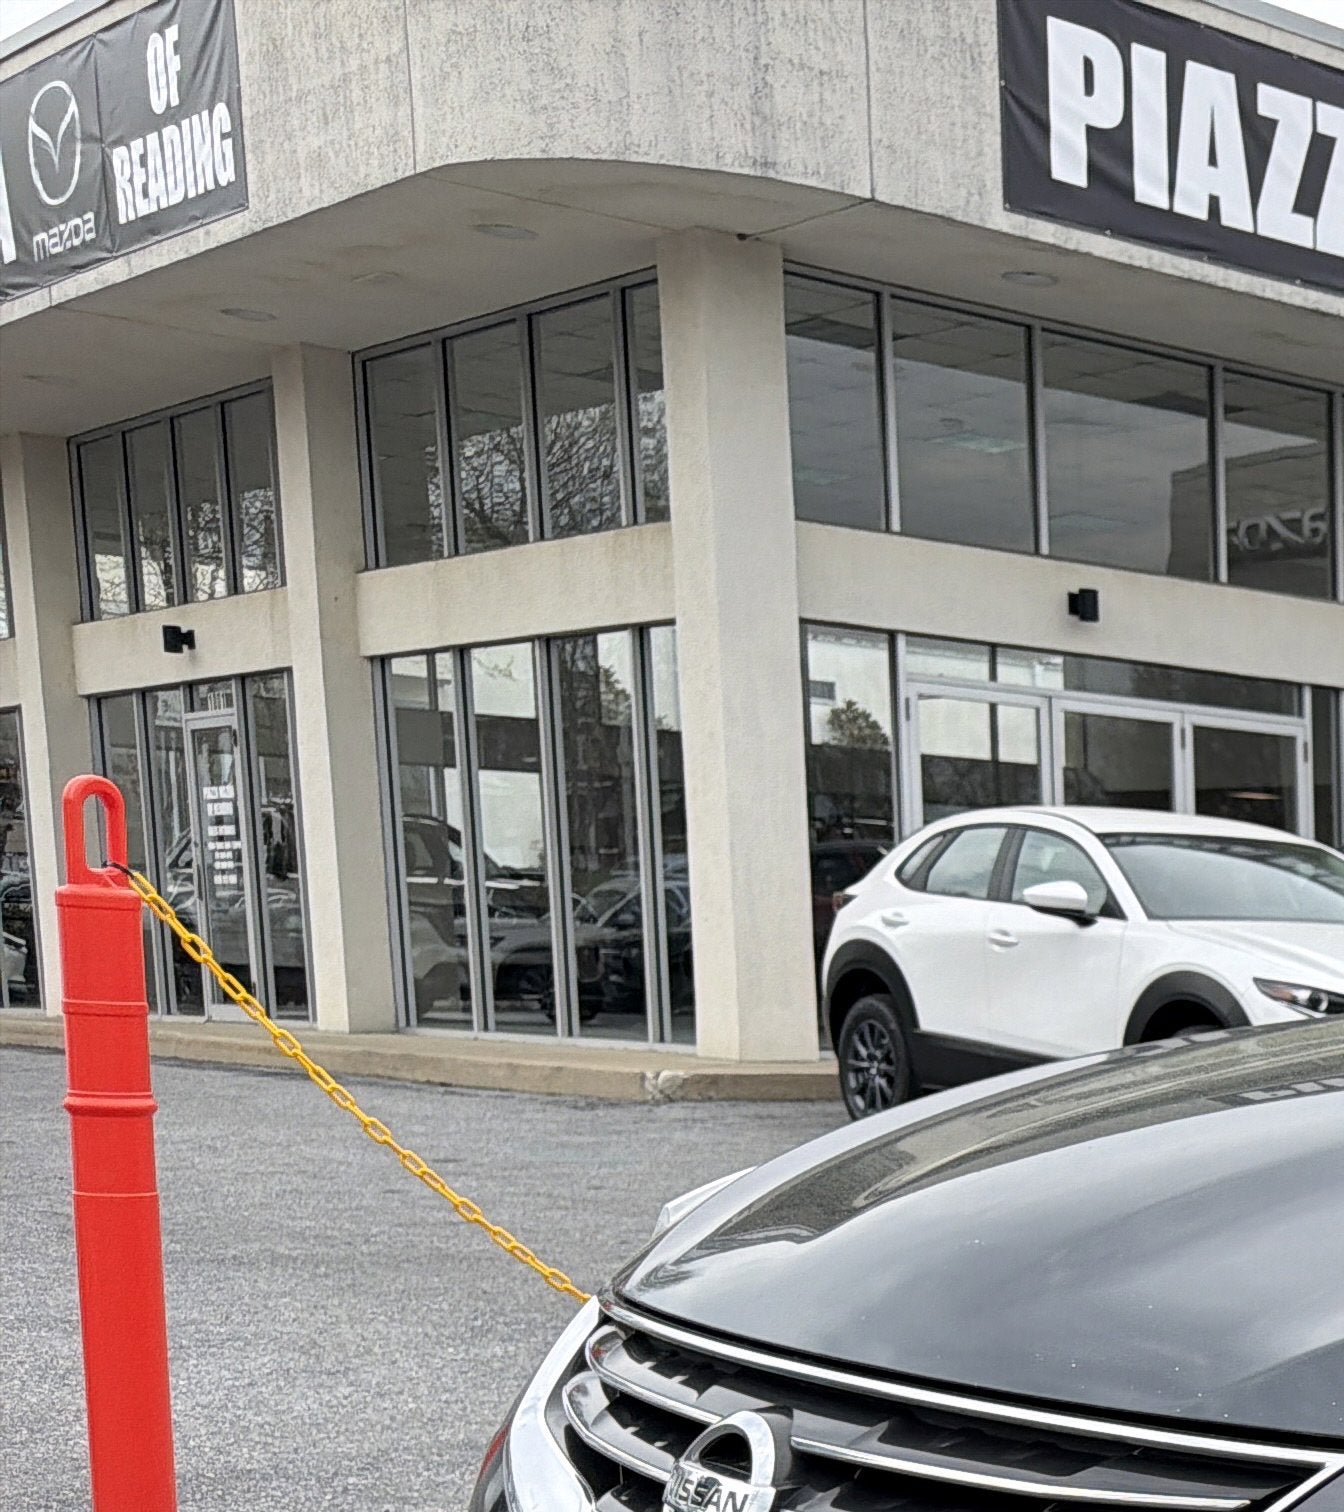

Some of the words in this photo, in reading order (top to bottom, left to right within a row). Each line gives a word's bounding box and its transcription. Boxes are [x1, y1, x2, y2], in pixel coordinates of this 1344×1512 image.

[146, 23, 181, 115] OF
[112, 102, 236, 225] READING
[32, 211, 97, 263] mazda
